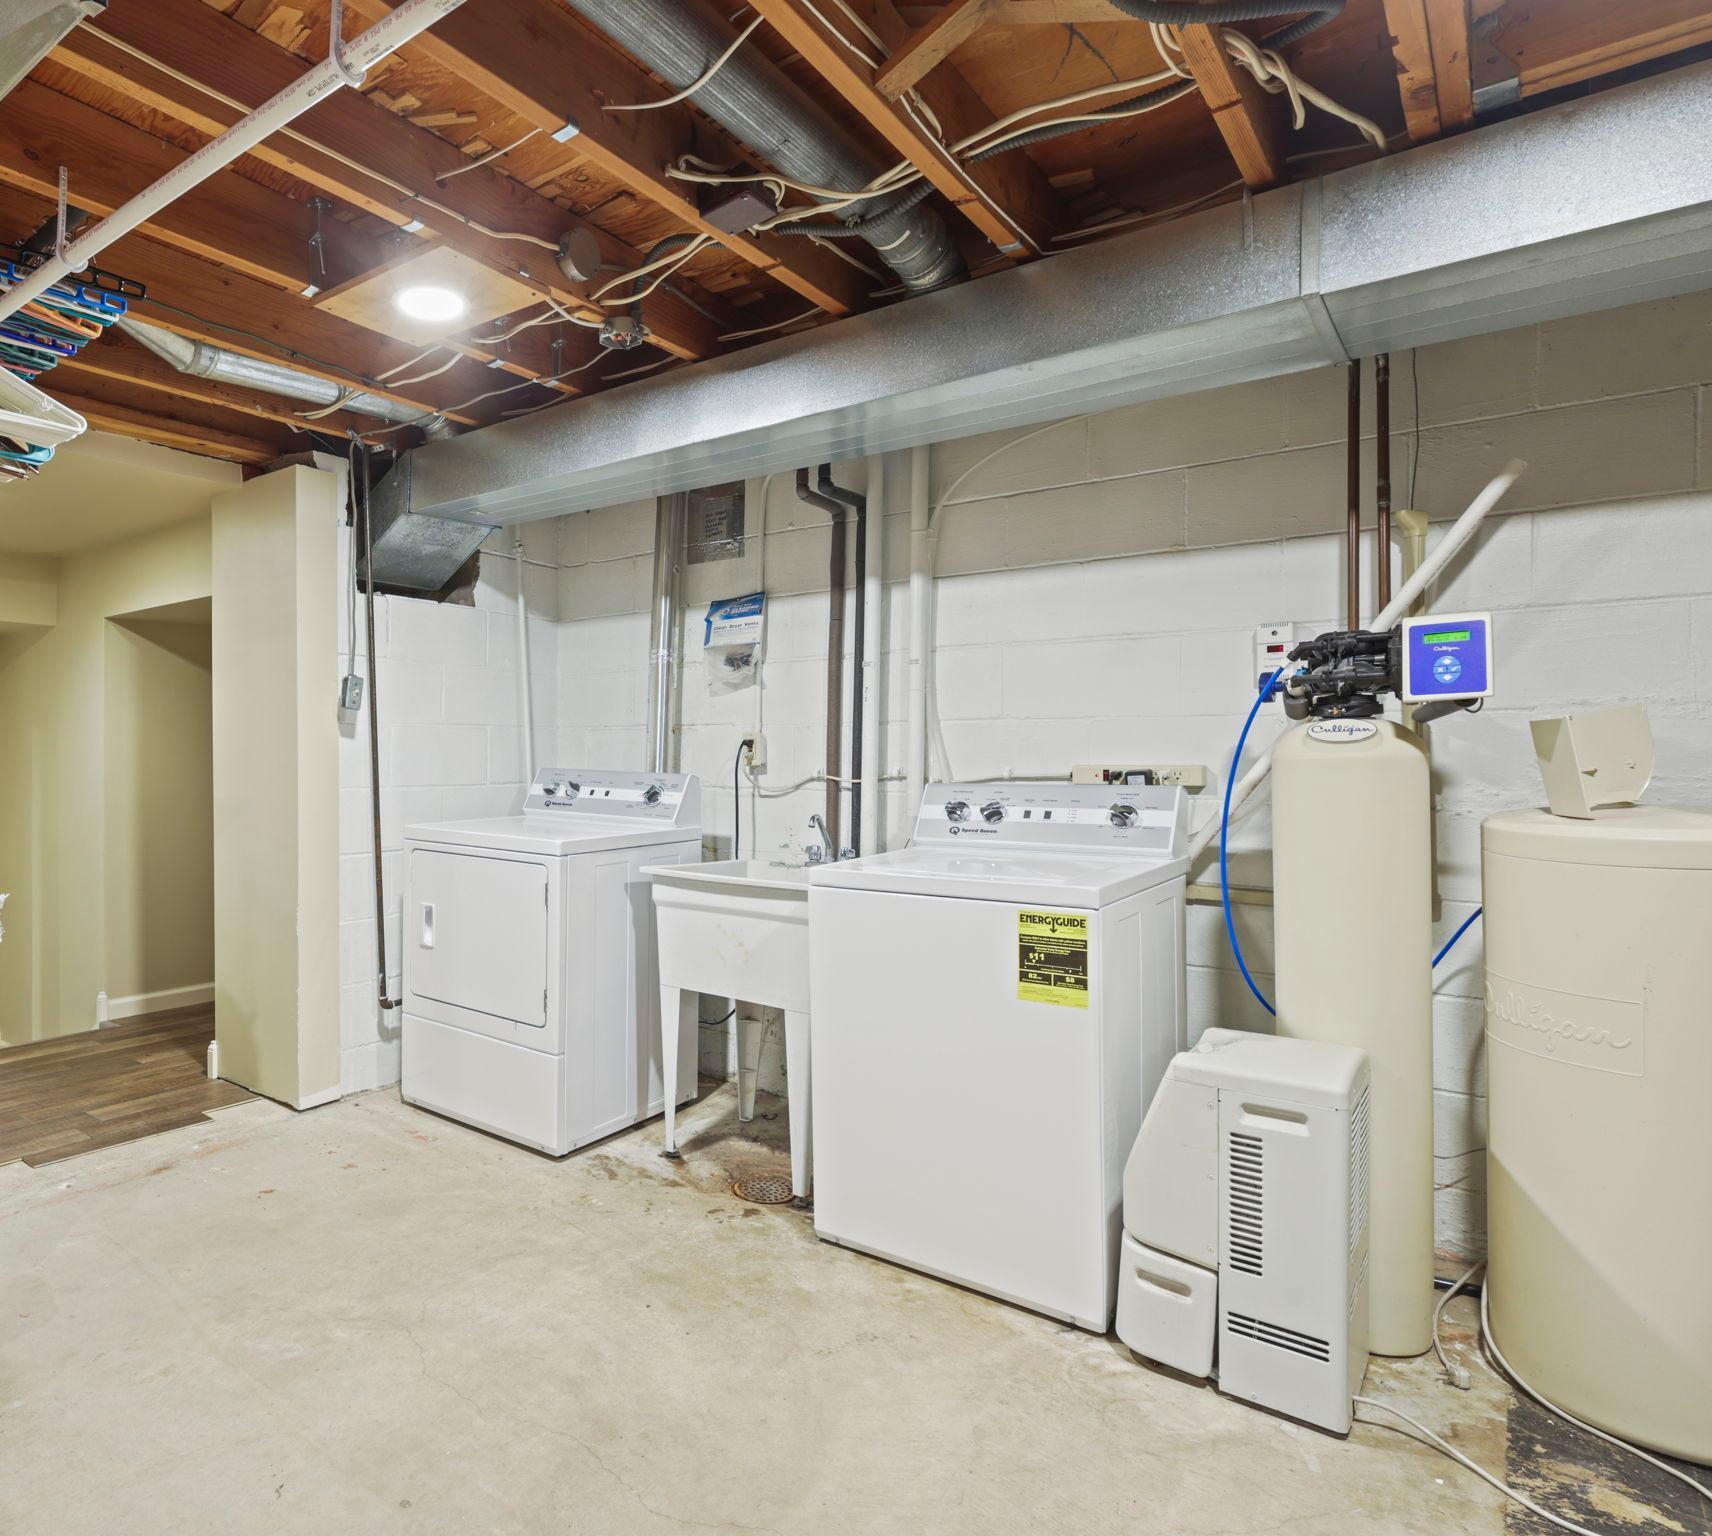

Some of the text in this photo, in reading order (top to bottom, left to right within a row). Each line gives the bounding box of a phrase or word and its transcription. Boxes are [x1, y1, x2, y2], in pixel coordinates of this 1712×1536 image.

[1311, 725, 1374, 736] Culligan
[1020, 913, 1087, 929] ENERGYGUIDE
[1028, 952, 1045, 961] $11
